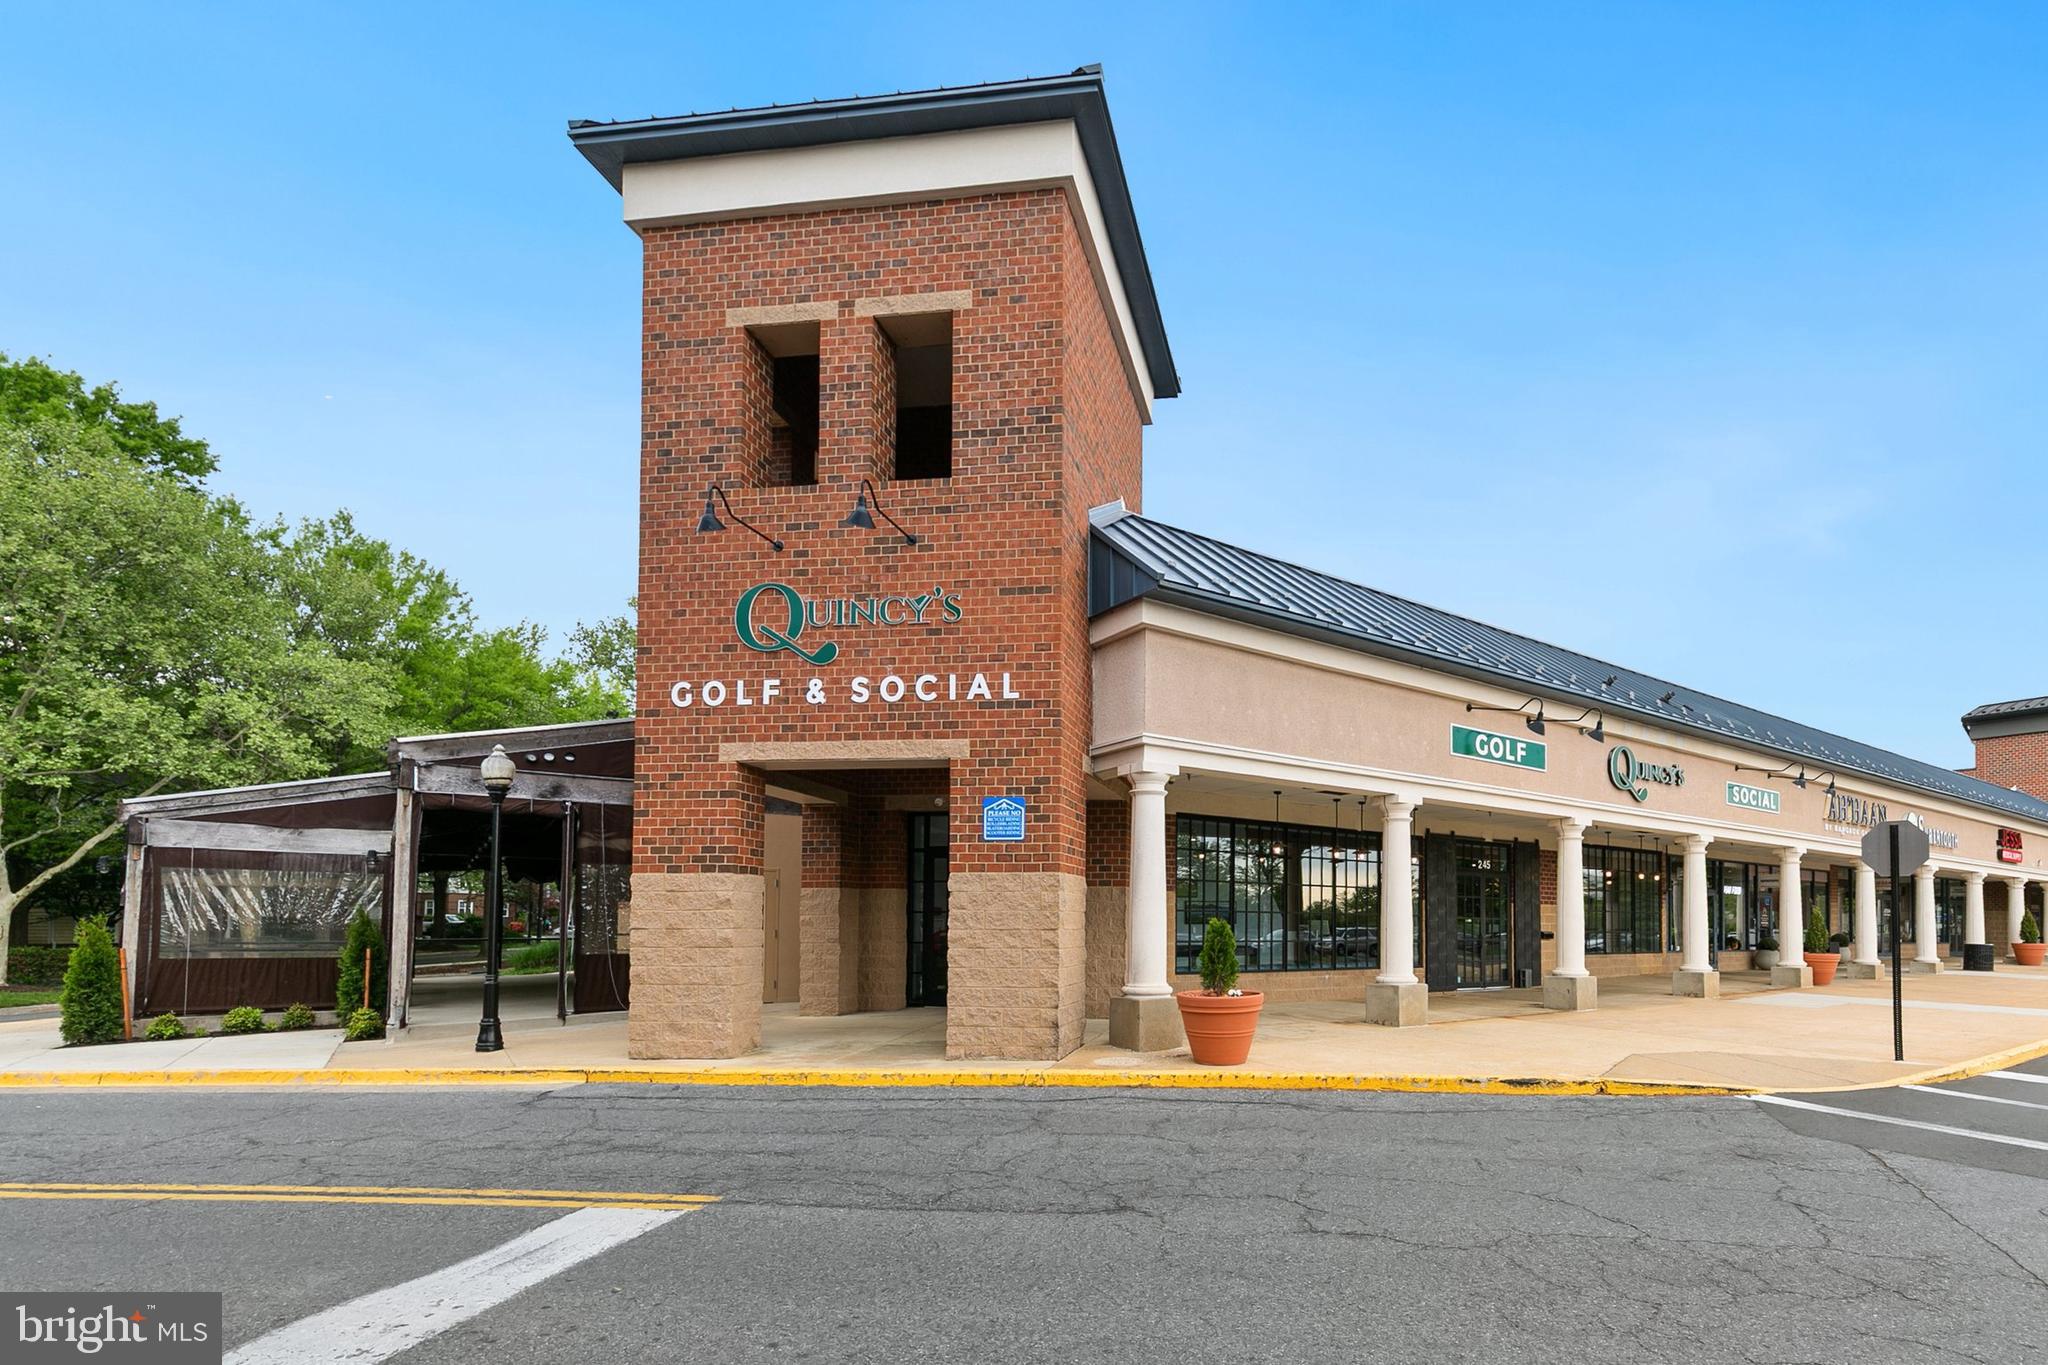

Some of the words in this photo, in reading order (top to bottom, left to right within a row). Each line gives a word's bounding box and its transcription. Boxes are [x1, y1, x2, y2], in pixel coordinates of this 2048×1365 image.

[735, 582, 963, 665] QUINCY'S
[671, 680, 780, 708] GOLF
[805, 678, 826, 704] &
[850, 672, 1020, 703] SOCIAL
[1475, 734, 1526, 762] GOLF
[1607, 745, 1686, 801] QUINCY'S
[1733, 786, 1776, 809] SOCIAL
[1477, 860, 1491, 870] 245
